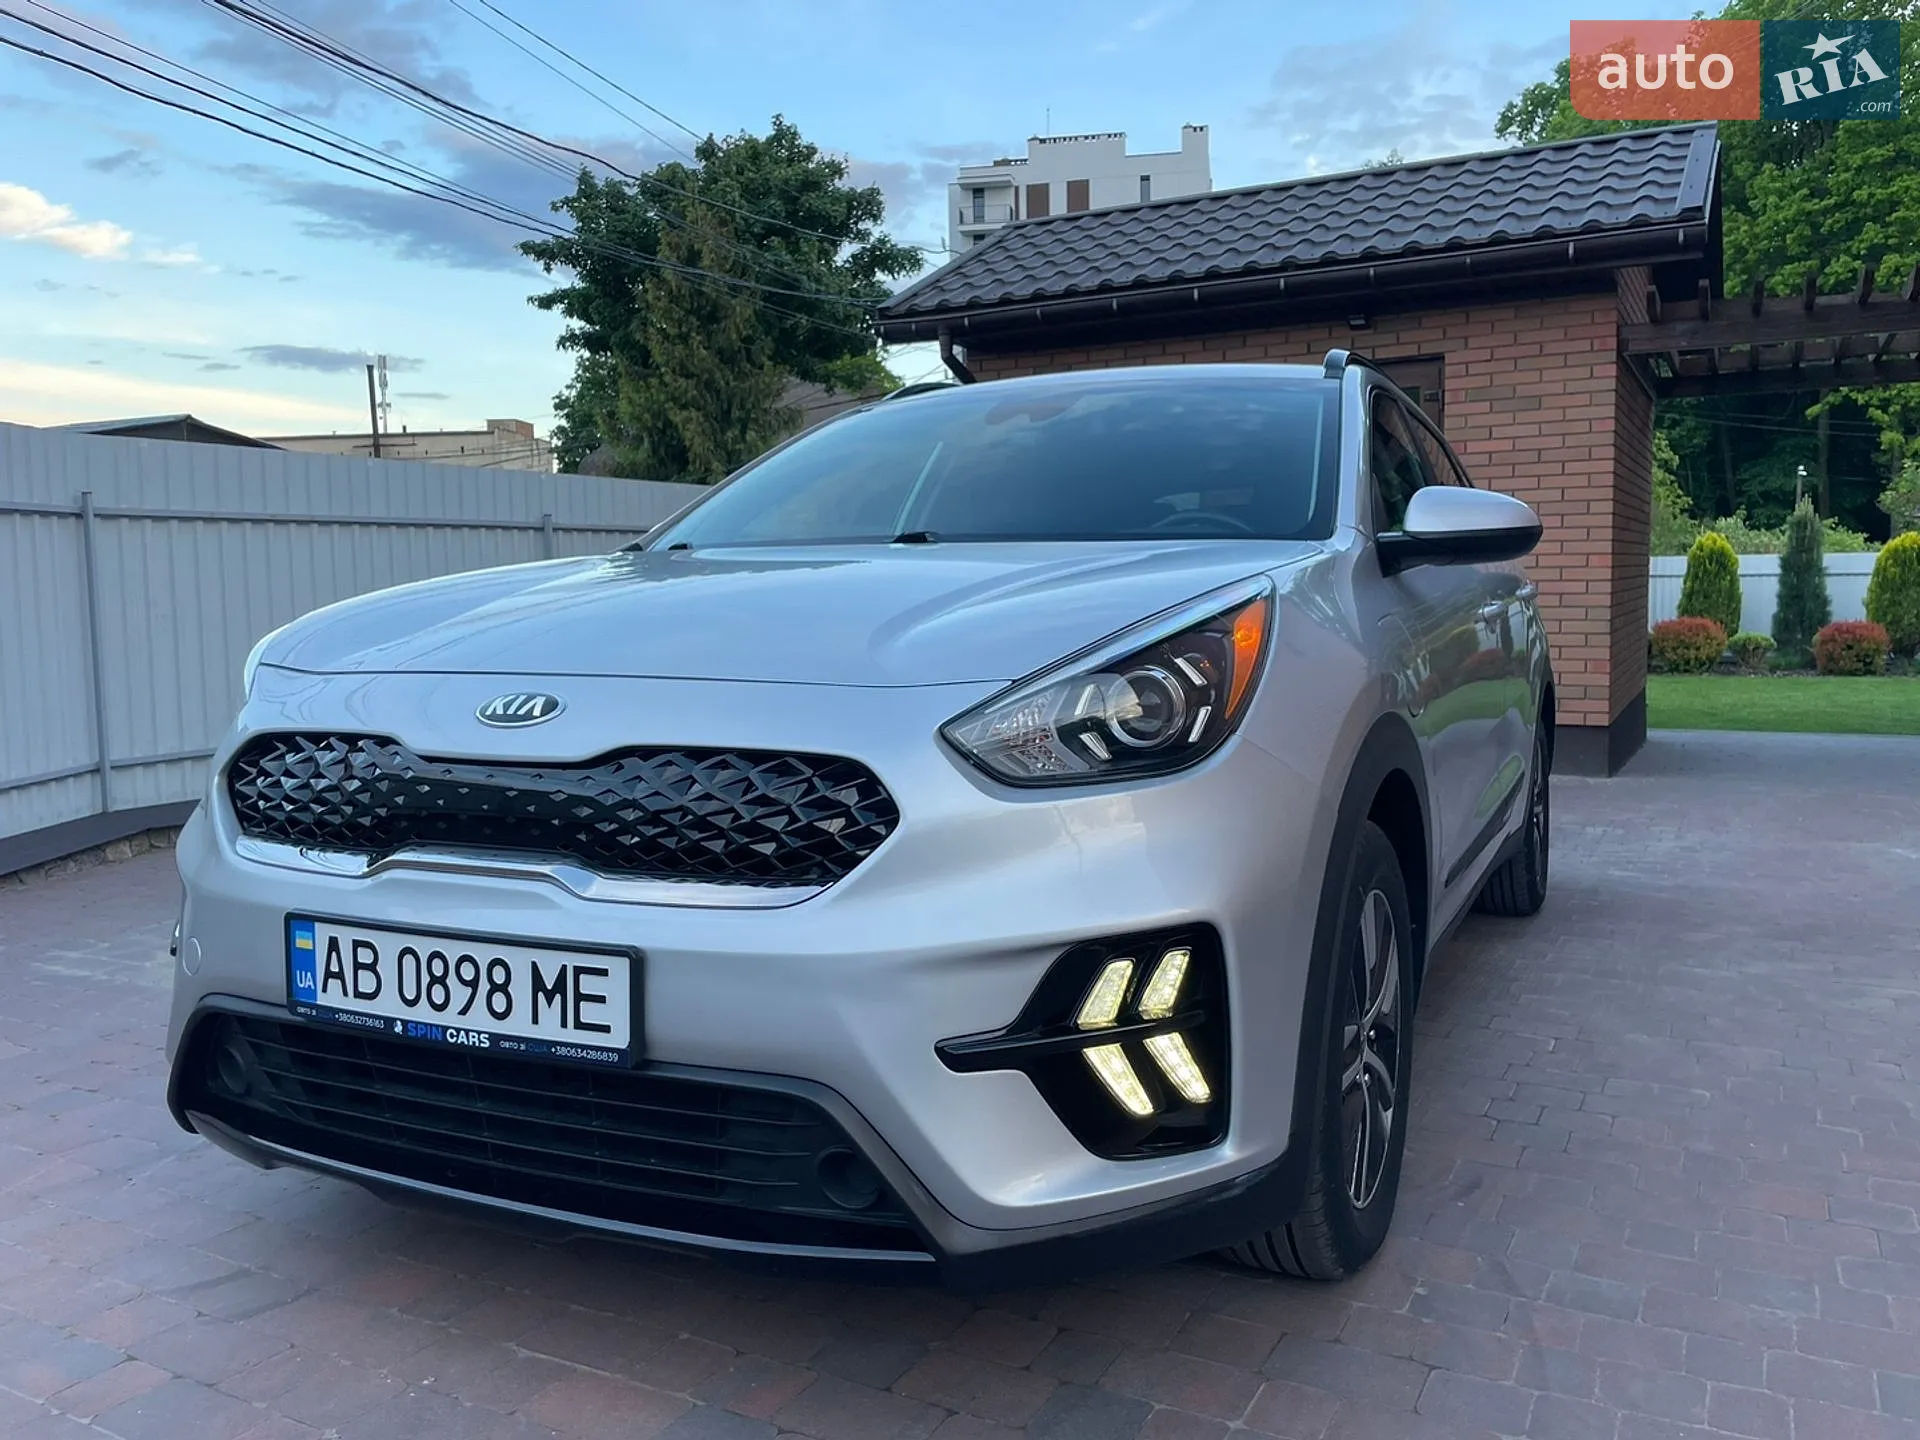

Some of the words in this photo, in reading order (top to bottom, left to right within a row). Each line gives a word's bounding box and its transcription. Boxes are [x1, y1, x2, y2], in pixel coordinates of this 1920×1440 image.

[484, 694, 547, 717] KIA
[296, 970, 316, 990] UA
[321, 935, 383, 1001] AB
[397, 946, 514, 1021] 0898
[530, 960, 612, 1034] ME
[407, 1022, 443, 1041] SPIN
[446, 1028, 490, 1048] CARS
